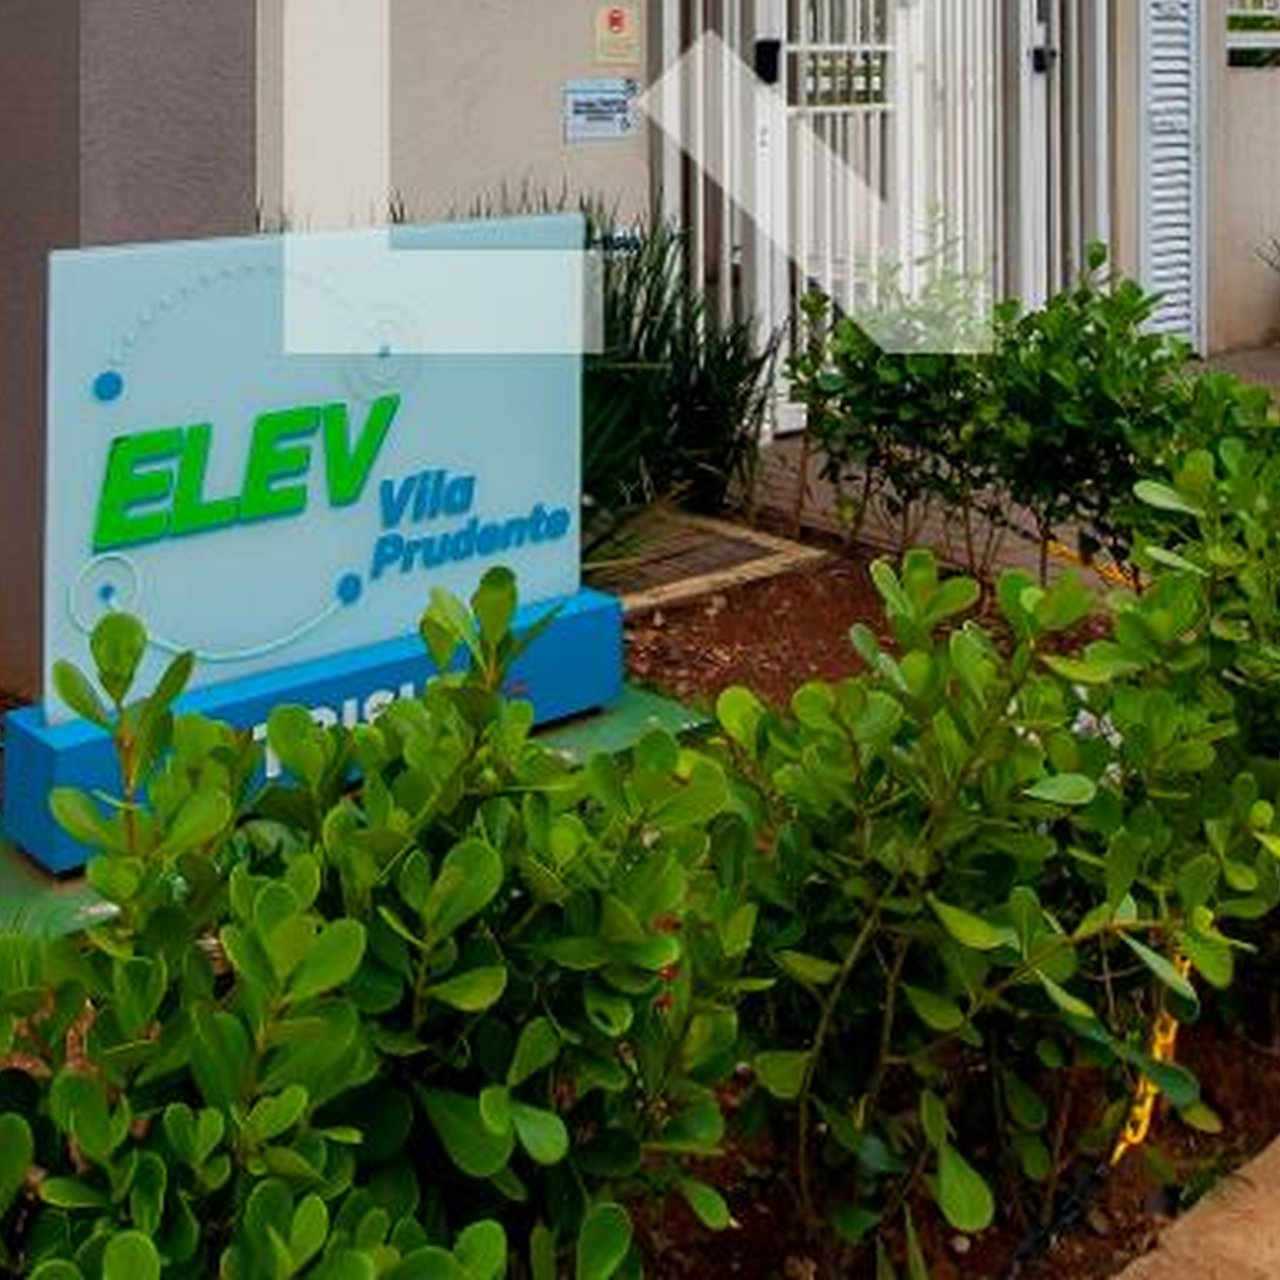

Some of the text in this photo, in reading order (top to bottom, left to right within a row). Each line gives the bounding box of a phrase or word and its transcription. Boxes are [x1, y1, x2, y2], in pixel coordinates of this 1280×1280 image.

[93, 393, 401, 554] ELEV
[378, 467, 476, 528] Vila
[370, 503, 572, 580] Prudente
